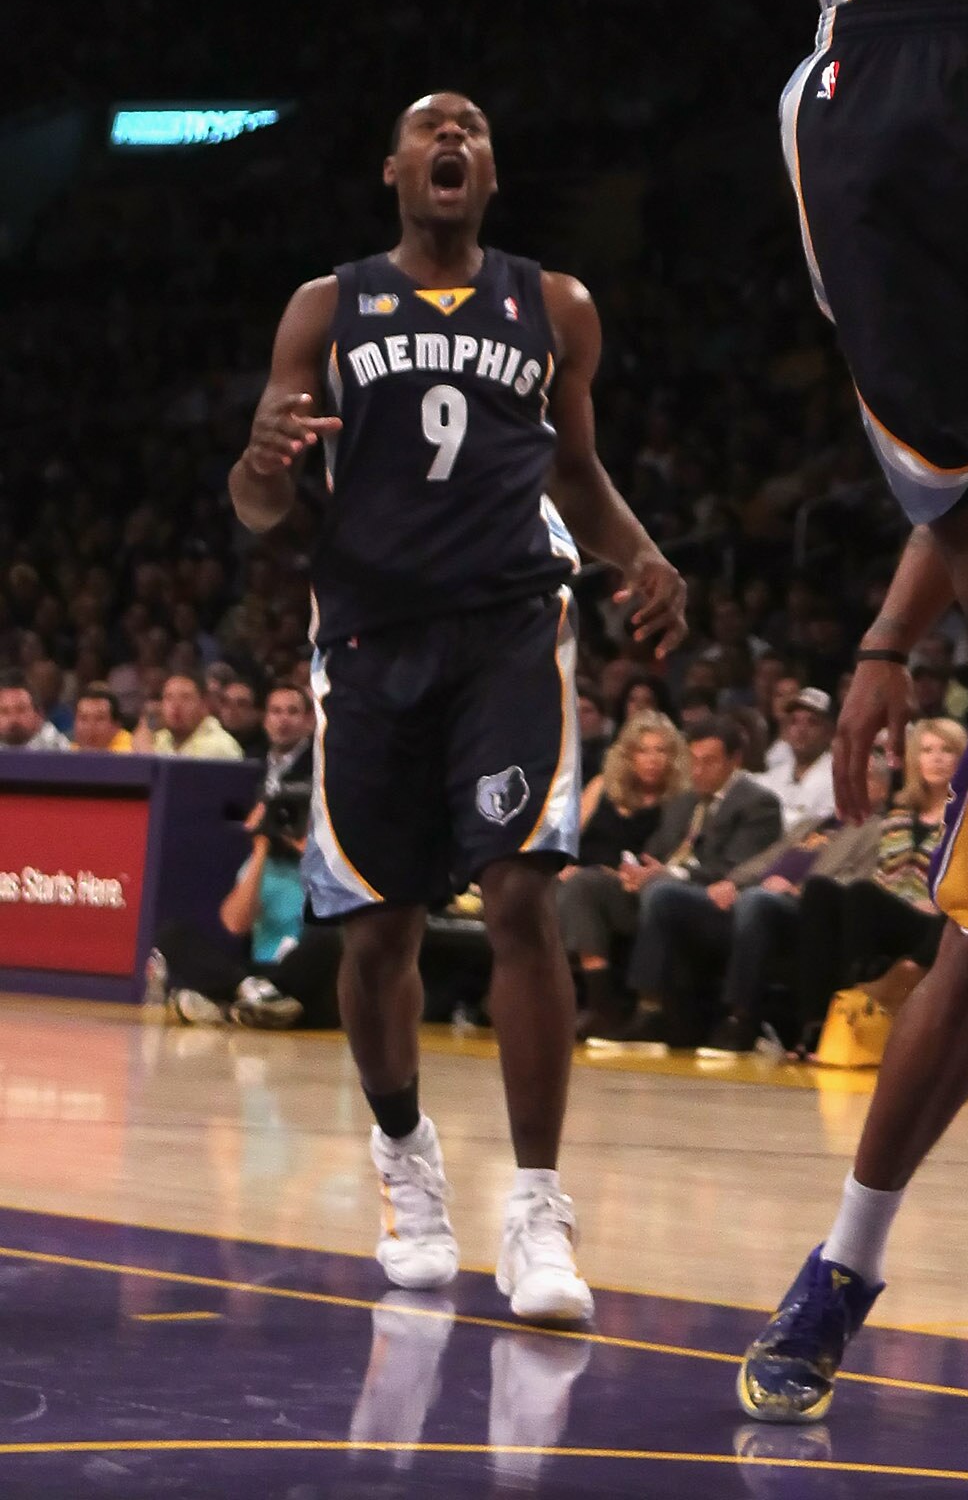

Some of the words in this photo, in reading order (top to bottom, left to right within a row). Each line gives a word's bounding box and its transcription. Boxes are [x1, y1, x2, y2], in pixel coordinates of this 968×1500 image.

[347, 332, 542, 397] MEMPHIS
[421, 384, 468, 482] 9
[0, 871, 22, 903] as
[21, 865, 76, 906] Starts
